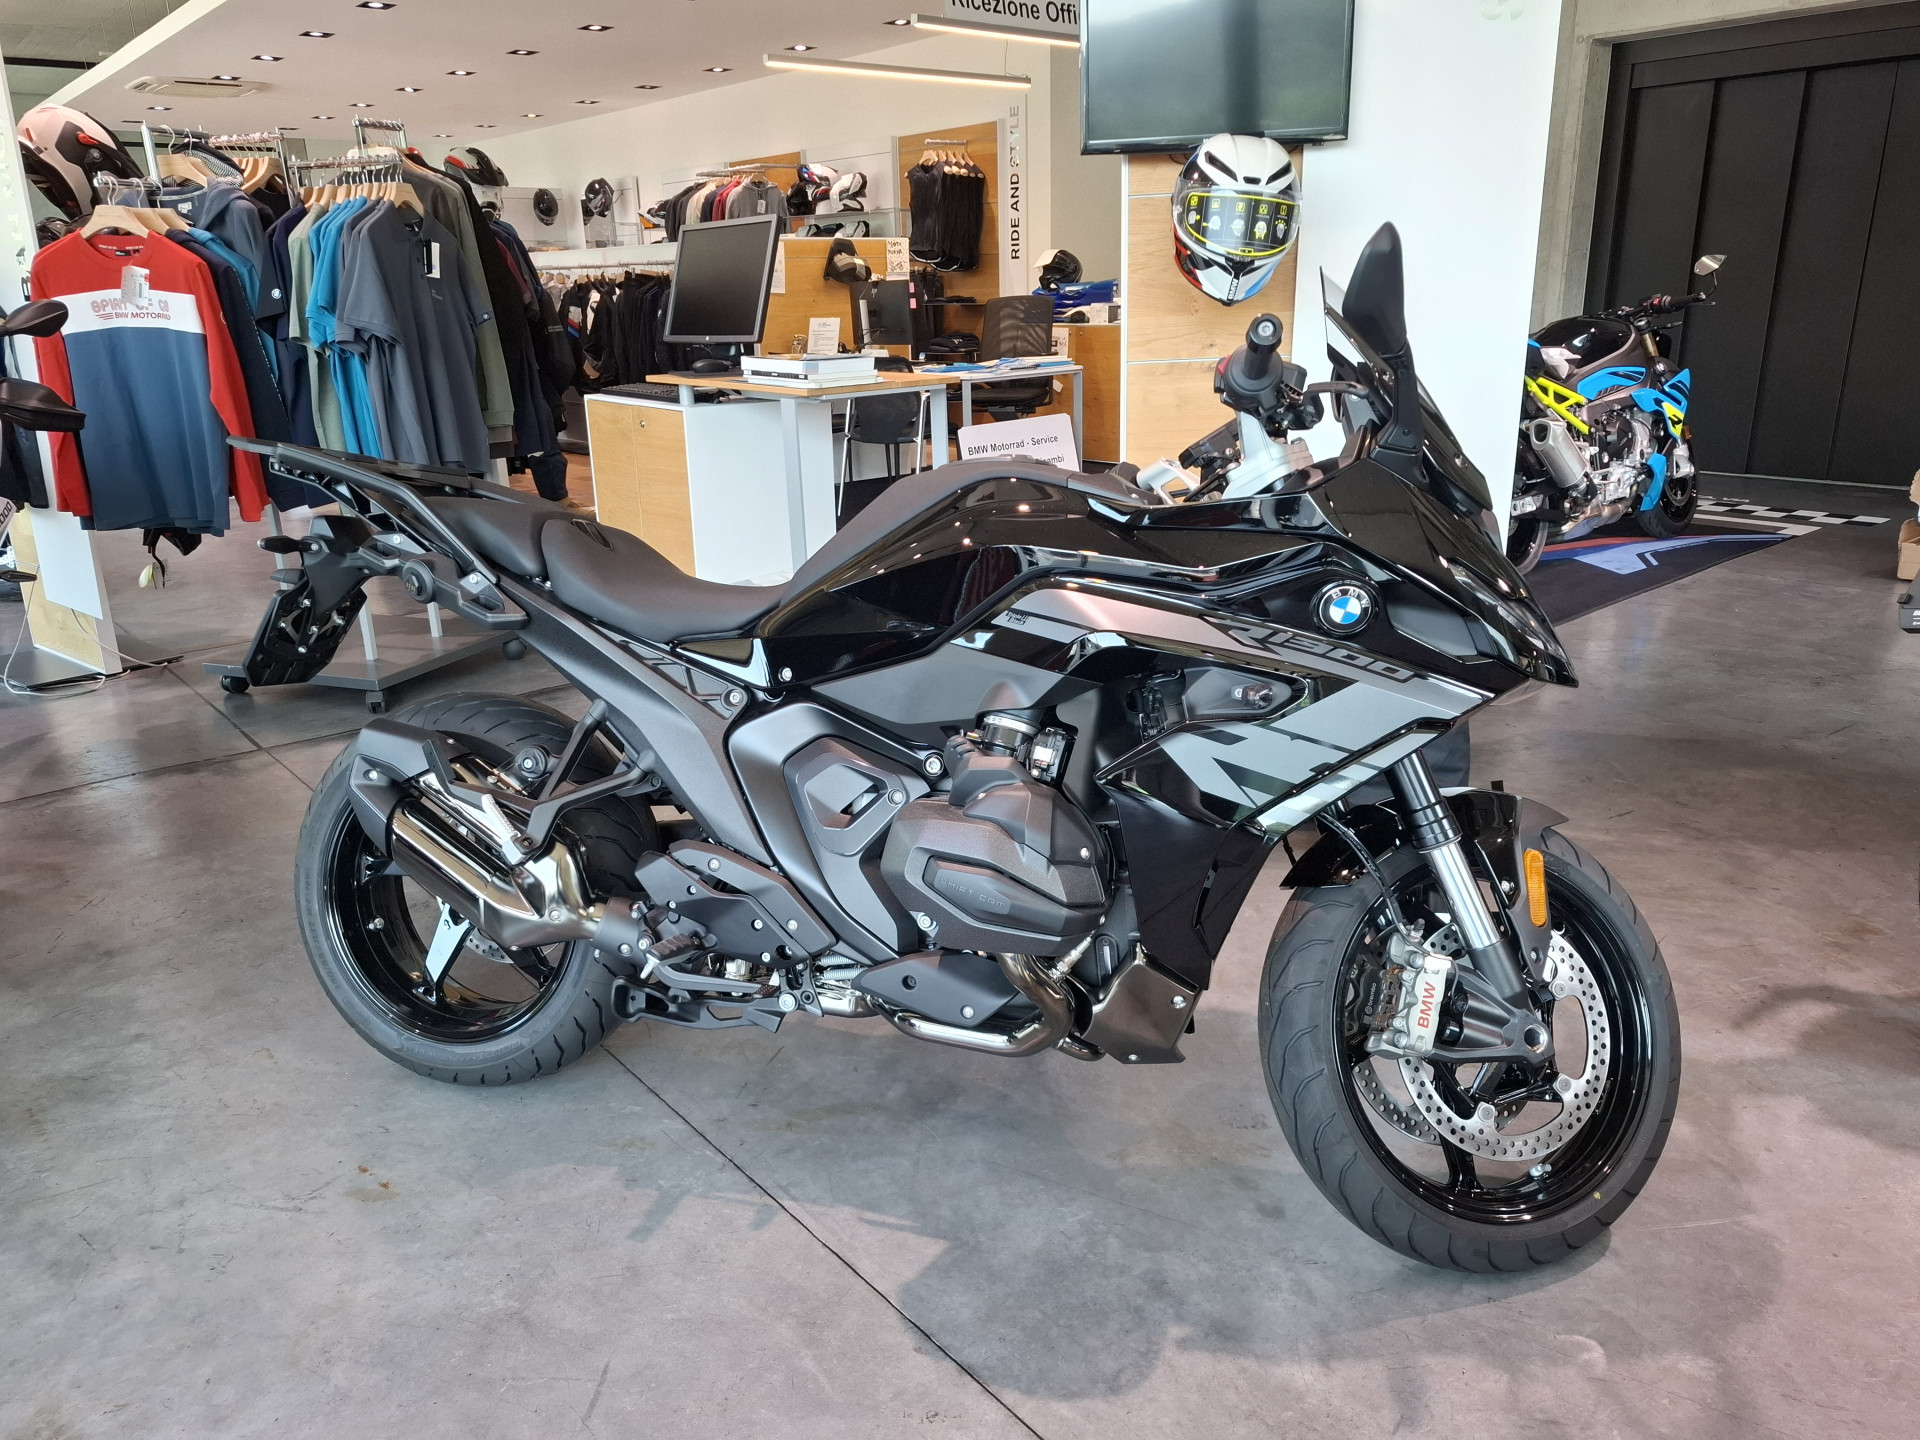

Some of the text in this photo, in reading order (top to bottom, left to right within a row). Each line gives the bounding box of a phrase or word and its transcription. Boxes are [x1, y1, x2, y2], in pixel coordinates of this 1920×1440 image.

[951, 0, 1080, 24] cezione Offi
[1009, 105, 1020, 260] RIDE AND STYLE
[1227, 278, 1239, 301] BMW
[967, 444, 989, 456] BMW
[990, 438, 1025, 453] Motorrad
[1030, 434, 1059, 446] Service
[1331, 588, 1370, 609] BMW
[939, 876, 1007, 910] SHIFT CAM
[1368, 983, 1377, 1006] brembo
[1417, 981, 1436, 1029] BMW
